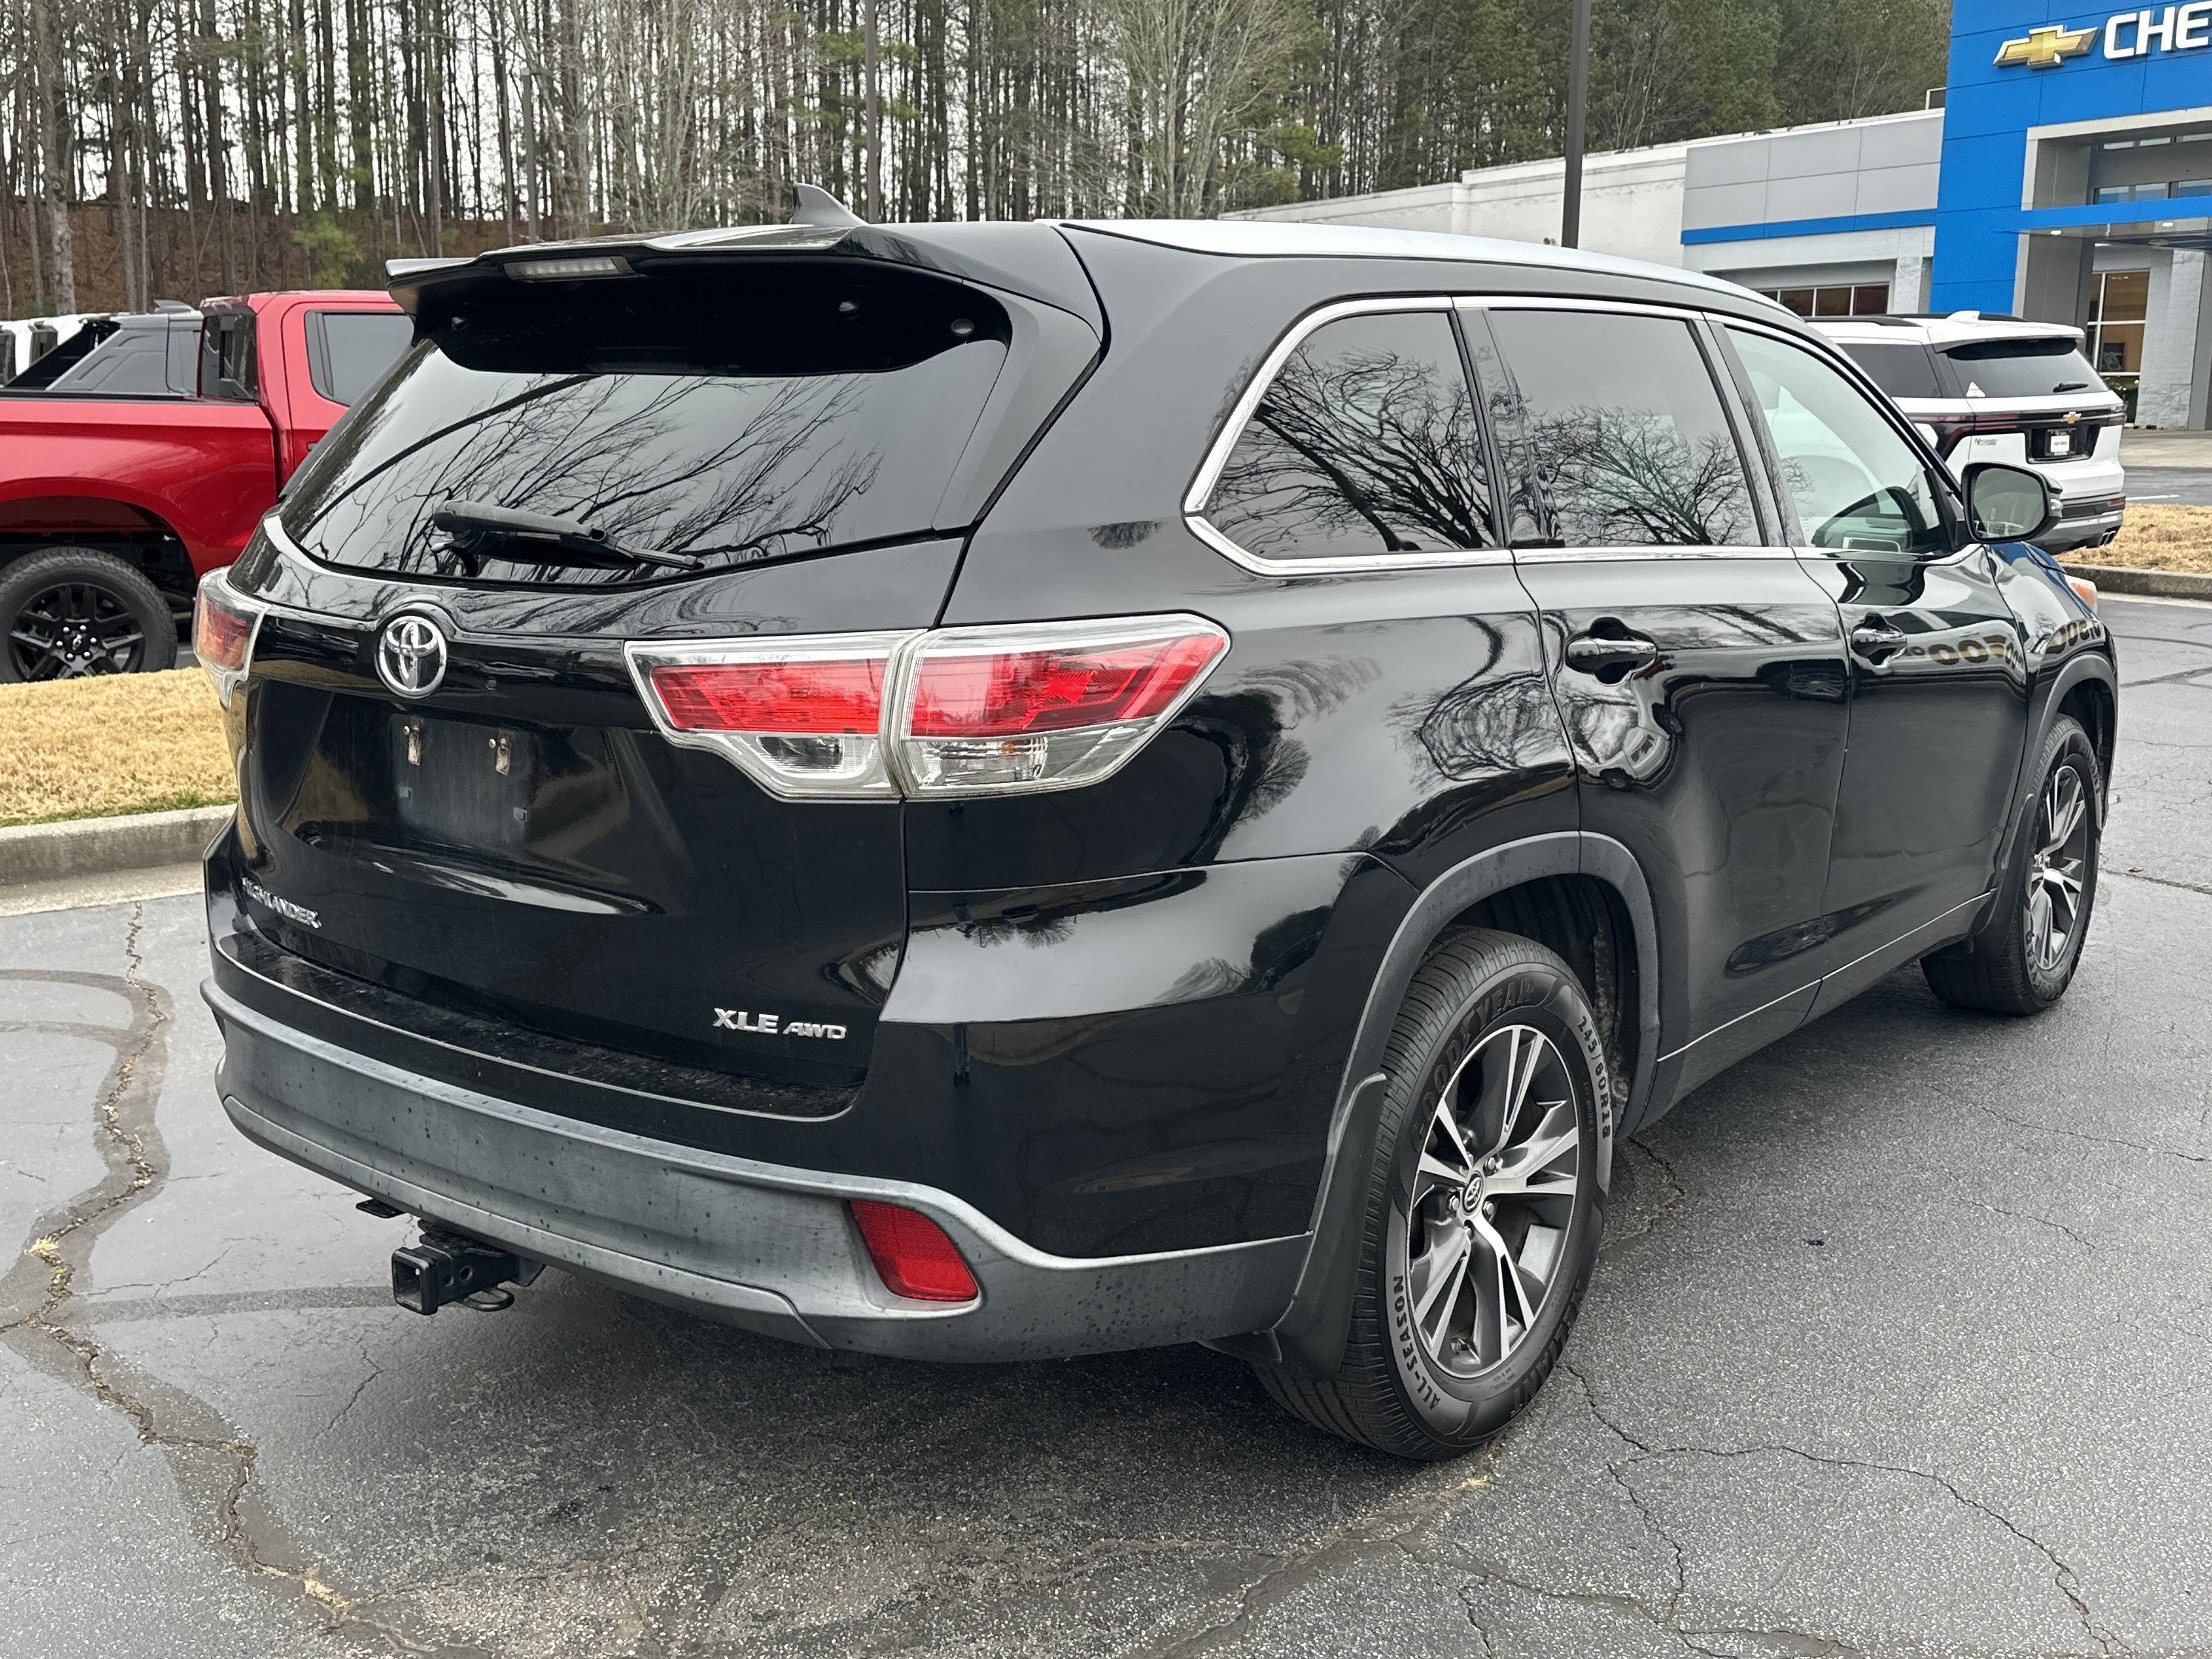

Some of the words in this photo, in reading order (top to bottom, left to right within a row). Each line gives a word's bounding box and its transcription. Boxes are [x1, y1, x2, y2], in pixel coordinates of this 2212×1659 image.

[2104, 1, 2212, 59] CHE
[712, 1008, 779, 1034] XLE
[783, 1022, 847, 1039] AWD
[1412, 978, 1534, 1152] GOODYEAR
[1577, 1015, 1611, 1139] 245/60R18
[1393, 1275, 1441, 1410] ALL-SEASON
